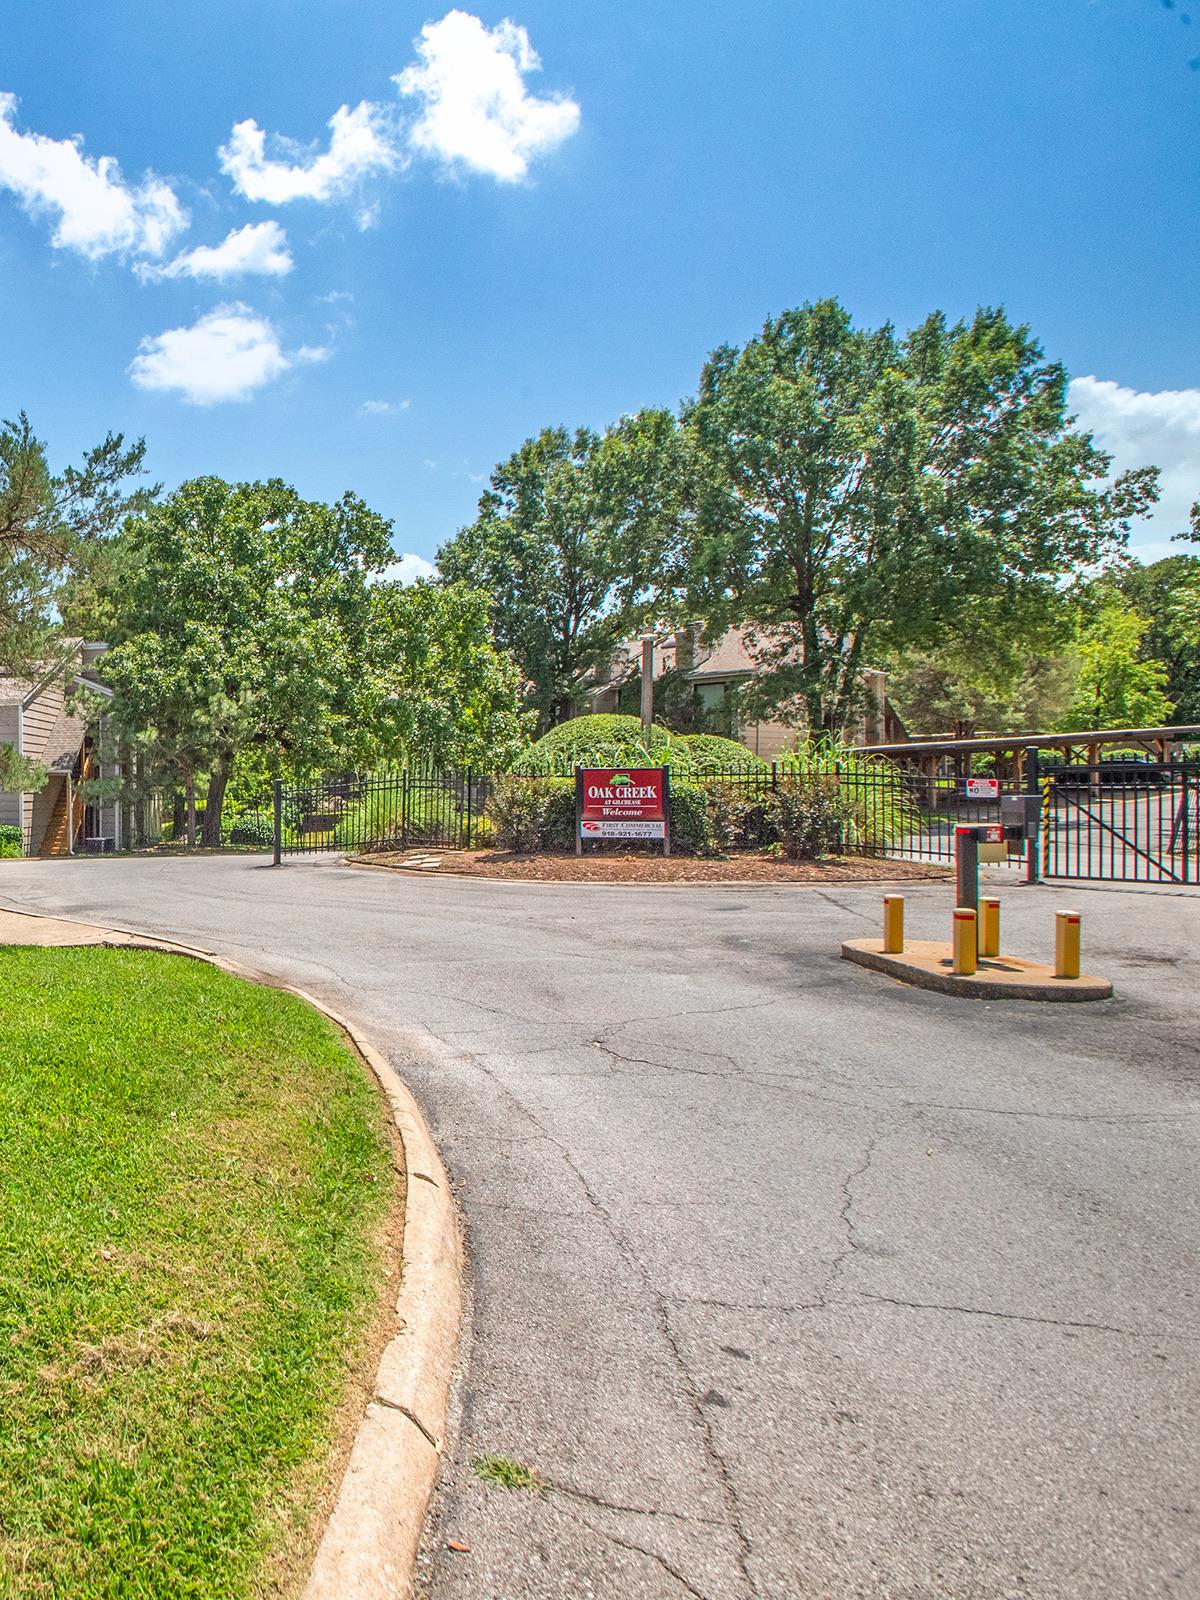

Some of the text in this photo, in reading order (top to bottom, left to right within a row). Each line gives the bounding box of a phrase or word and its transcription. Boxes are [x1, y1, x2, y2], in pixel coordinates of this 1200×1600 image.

[588, 786, 657, 798] OAK CREEK
[602, 807, 643, 816] Welcome
